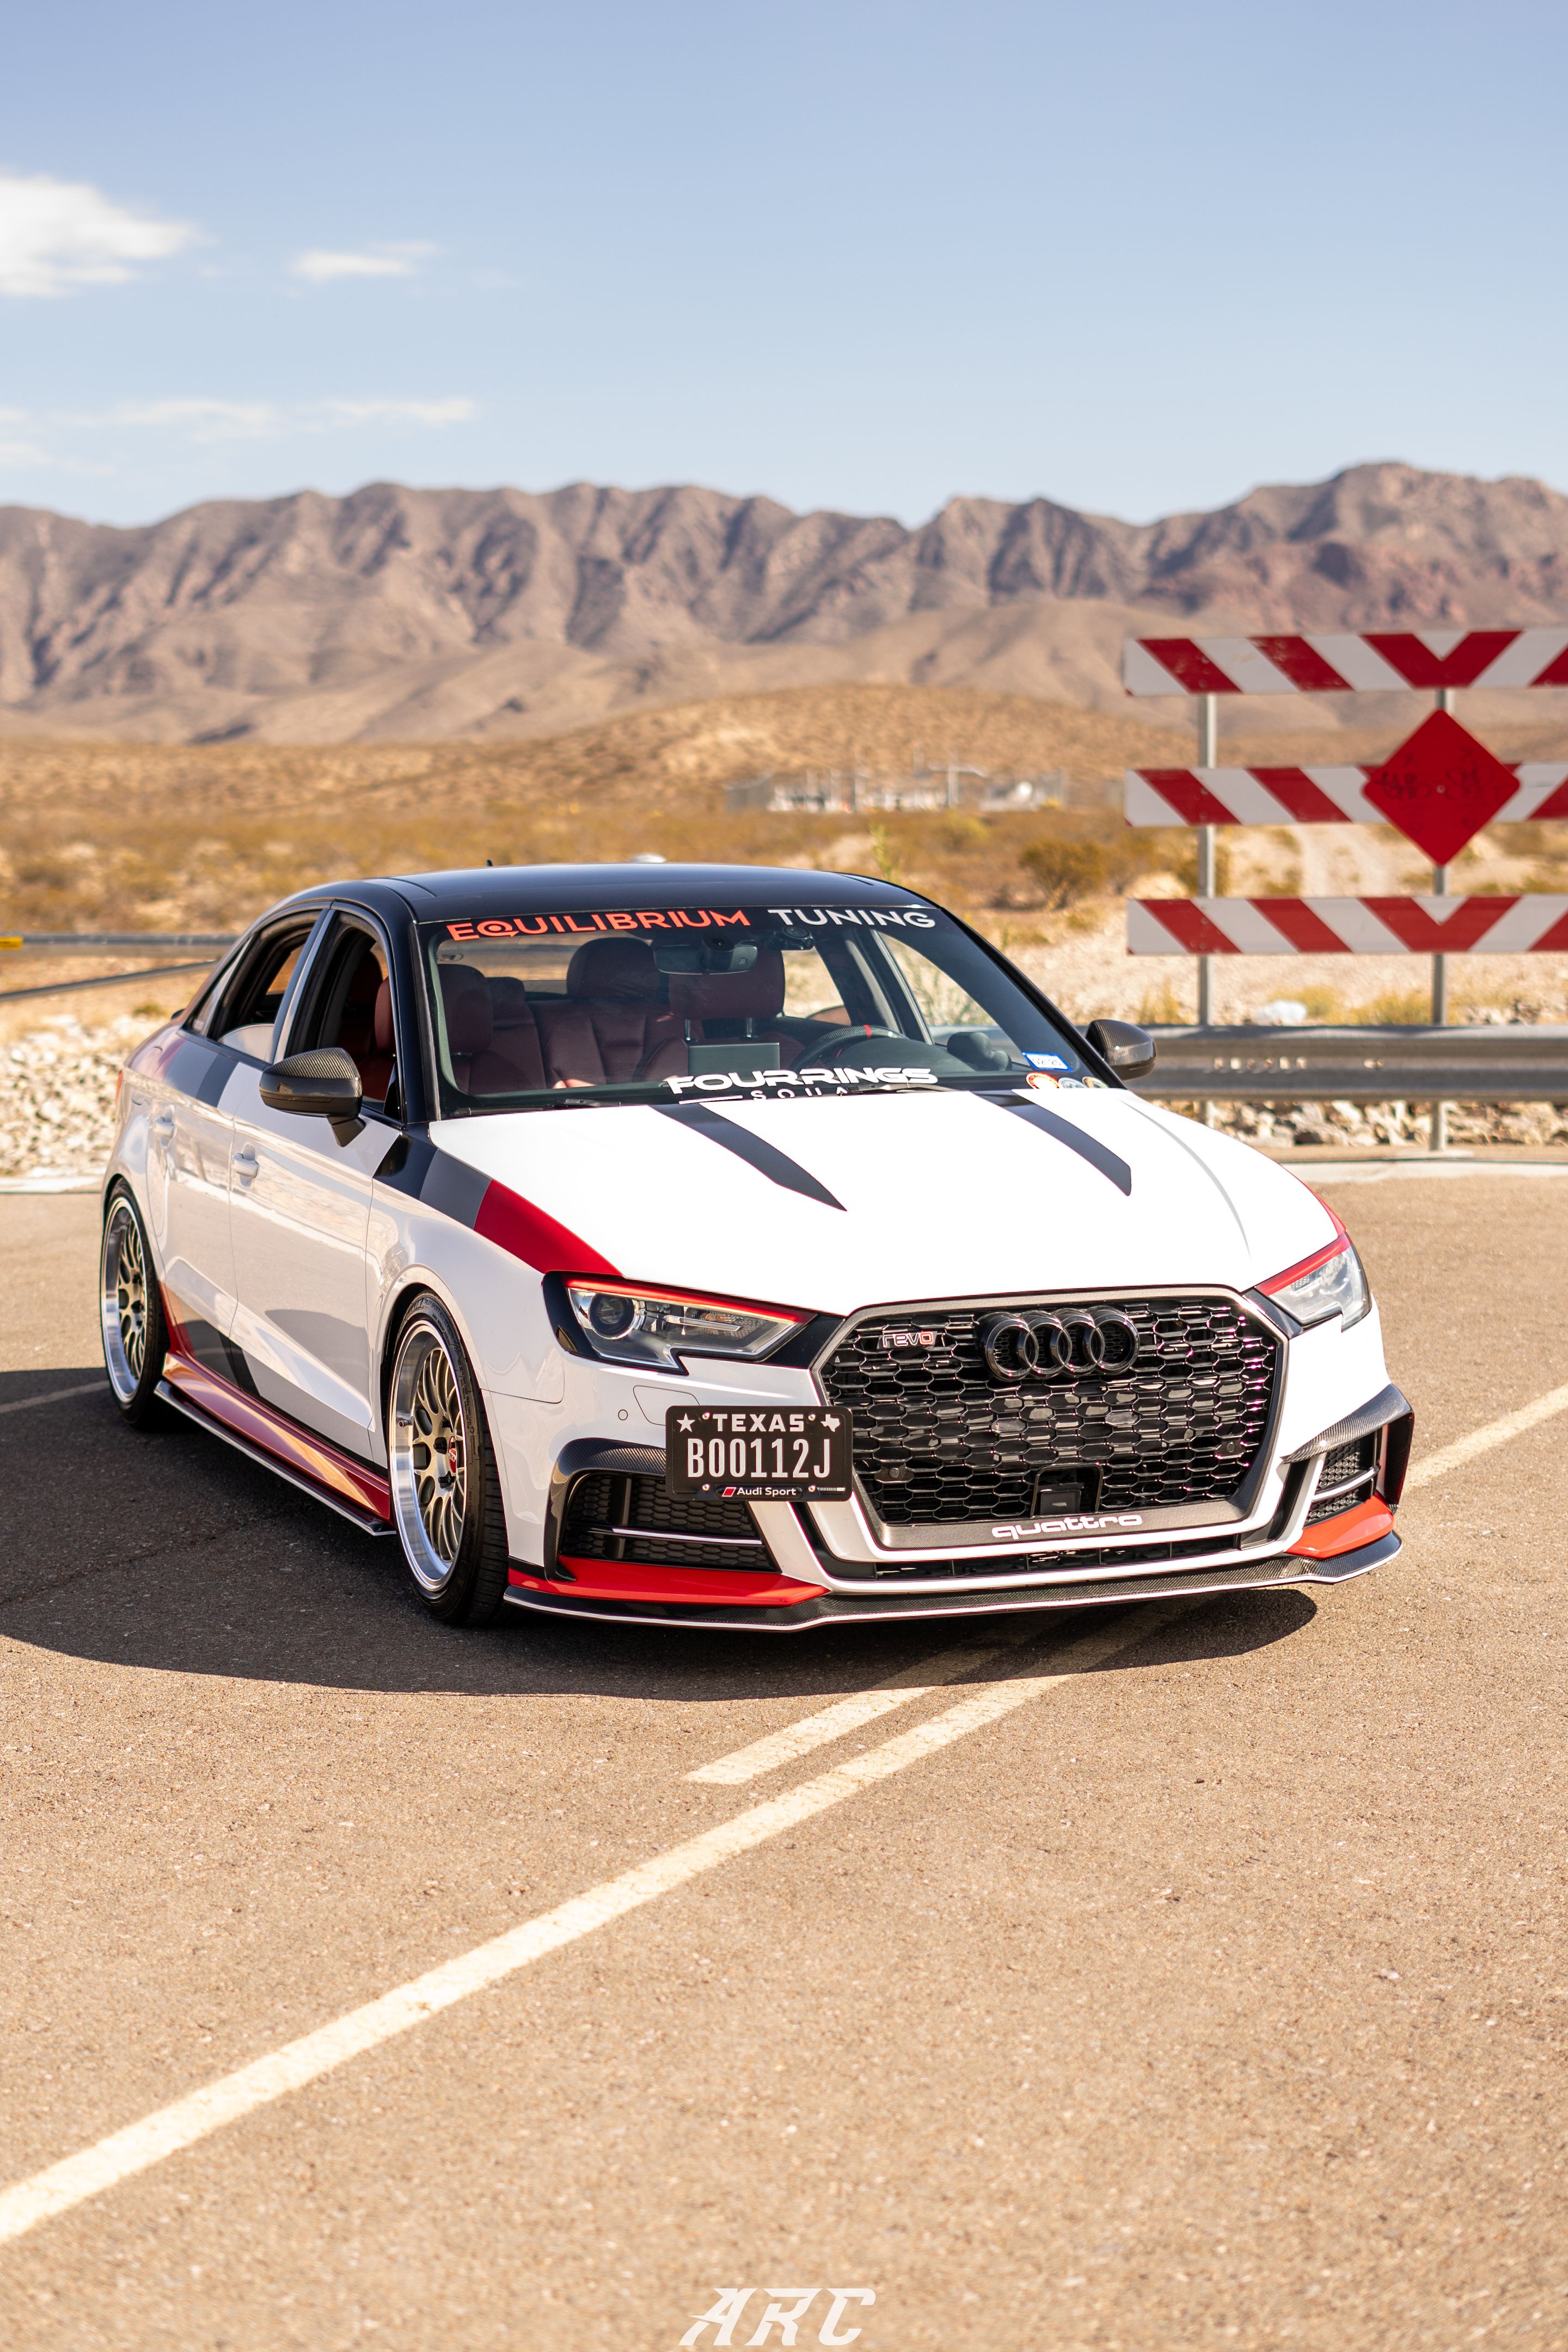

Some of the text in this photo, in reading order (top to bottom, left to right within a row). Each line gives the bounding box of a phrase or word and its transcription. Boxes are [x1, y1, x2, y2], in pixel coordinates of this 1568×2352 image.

[446, 909, 936, 941] EQUILIBRIUM TUNING
[666, 1068, 939, 1094] FOURRINGS
[713, 1413, 805, 1432] TEXAS
[737, 1487, 797, 1498] Audi Sport
[991, 1514, 1142, 1540] quattro
